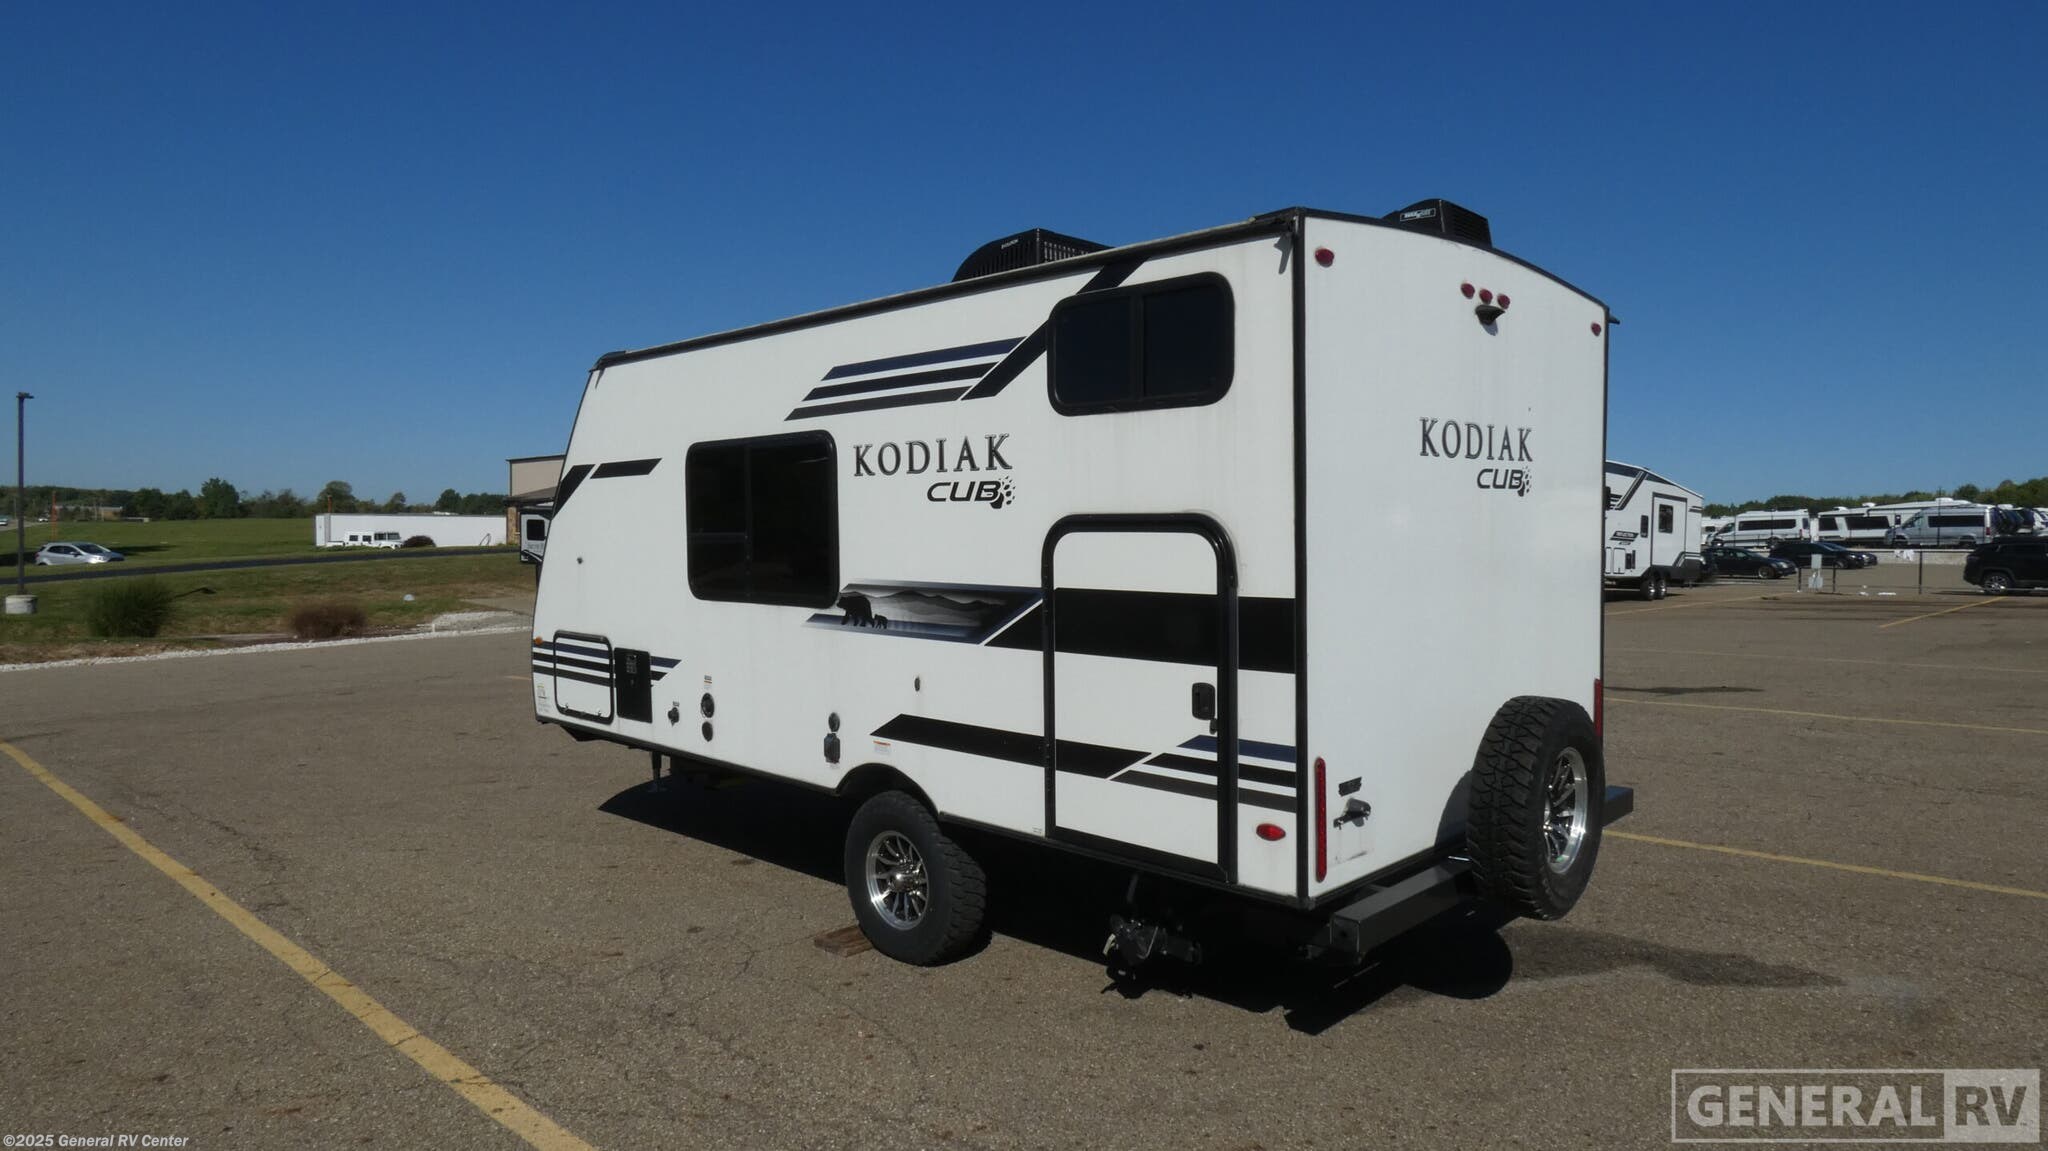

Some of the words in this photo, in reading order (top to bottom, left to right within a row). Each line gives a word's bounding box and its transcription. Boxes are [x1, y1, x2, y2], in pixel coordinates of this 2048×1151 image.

[853, 433, 1013, 477] KODIAK
[1419, 417, 1533, 462] KODIAK
[926, 480, 1002, 503] CUB
[1477, 468, 1524, 490] CUB
